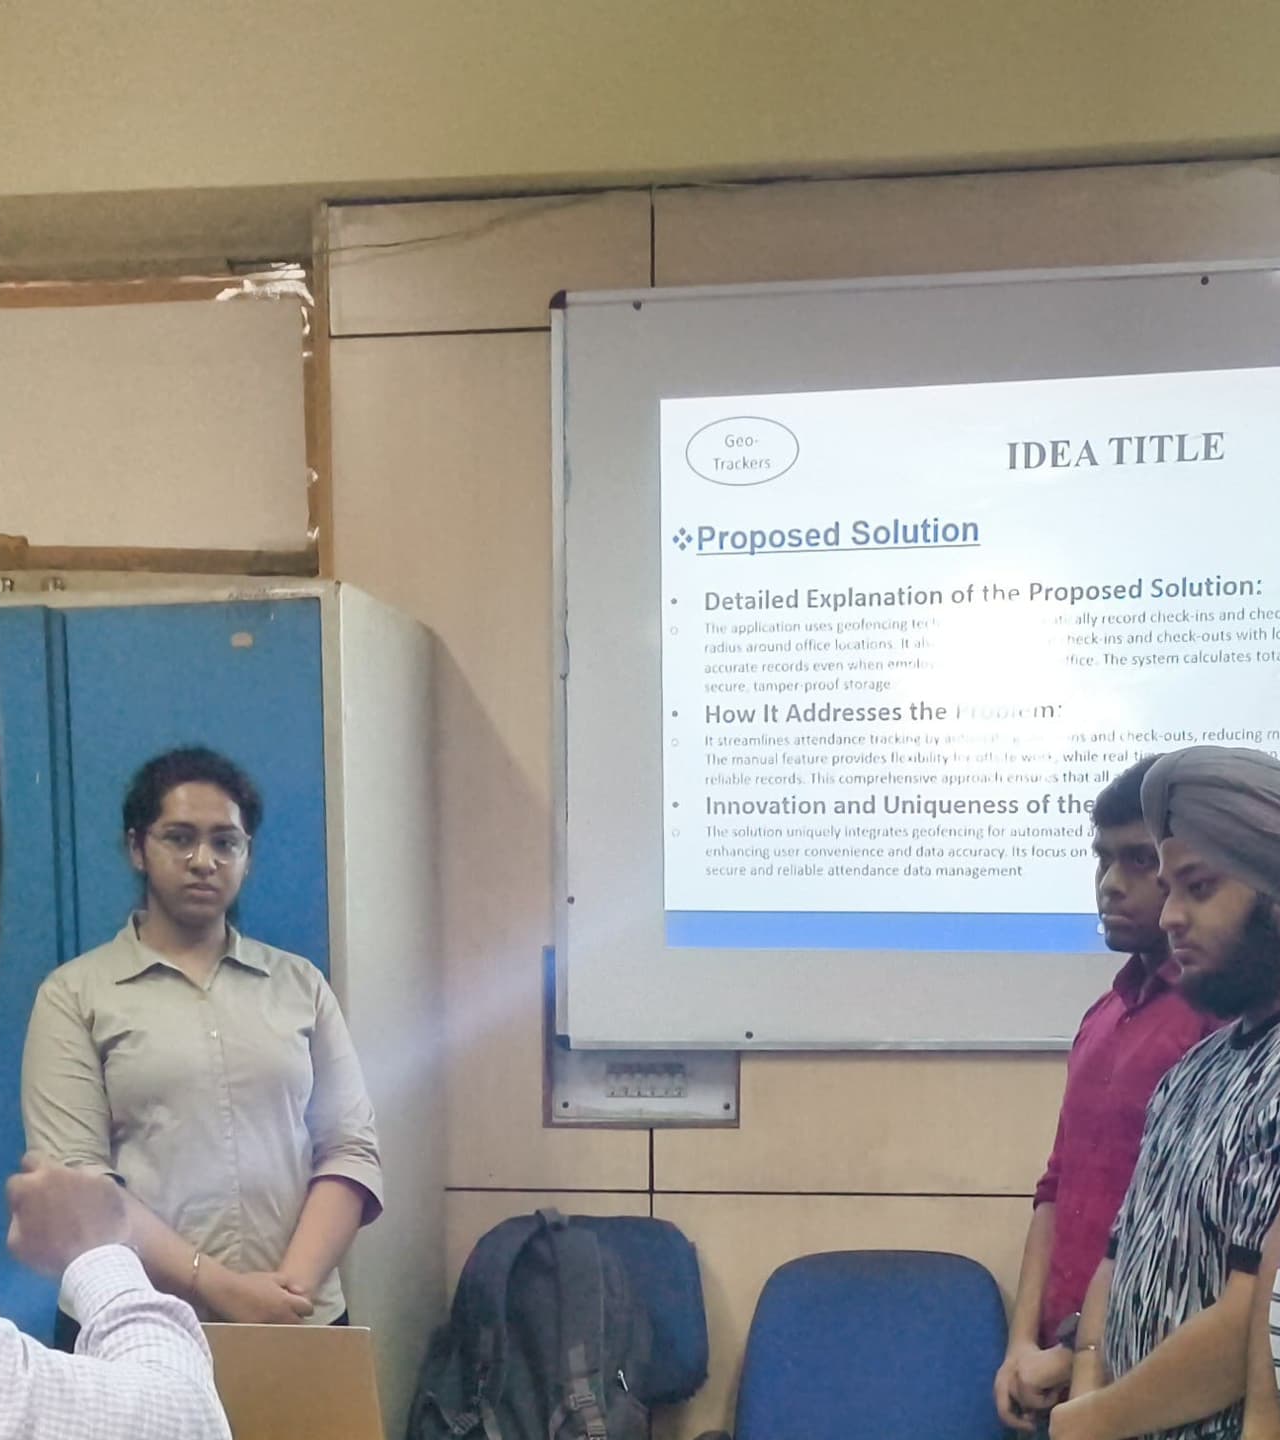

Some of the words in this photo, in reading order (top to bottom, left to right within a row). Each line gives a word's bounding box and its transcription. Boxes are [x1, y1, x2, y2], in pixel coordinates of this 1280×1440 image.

[724, 434, 759, 449] Geo-
[1007, 439, 1100, 470] IDEA
[1107, 431, 1226, 465] TITLE
[713, 455, 771, 472] Trackers
[697, 521, 840, 556] Proposed
[851, 517, 981, 547] Solution
[705, 589, 799, 611] Detailed
[807, 586, 942, 612] Explanation
[951, 584, 974, 604] of
[982, 583, 1020, 602] the
[1029, 577, 1142, 606] Proposed
[1150, 575, 1262, 598] Solution:
[705, 622, 728, 635] The
[731, 620, 801, 636] application
[805, 622, 833, 633] uses
[837, 618, 907, 635] geofencing
[1102, 611, 1146, 625] record
[1150, 608, 1215, 624] check-ins
[1219, 608, 1245, 621] and
[704, 641, 741, 654] radius
[746, 640, 791, 653] around
[795, 638, 831, 651] office
[1067, 632, 1123, 646] heck-ins
[1127, 631, 1152, 644] and
[1156, 629, 1232, 643] check-outs
[1236, 628, 1267, 641] with
[704, 661, 757, 675] accurate
[762, 660, 809, 673] records
[813, 662, 843, 672] even
[847, 659, 883, 671] when
[1104, 652, 1128, 666] The
[1132, 655, 1179, 668] system
[1183, 649, 1252, 664] calculates
[705, 704, 756, 724] How
[764, 704, 778, 723] It
[785, 702, 902, 723] Addresses
[909, 701, 947, 721] the
[718, 734, 790, 747] streamlines
[794, 733, 866, 747] attendance
[1091, 730, 1115, 743] and
[1202, 728, 1261, 743] reducing
[706, 753, 727, 766] The
[732, 752, 778, 766] manual
[782, 751, 827, 765] feature
[832, 751, 887, 767] provides
[1063, 750, 1098, 763] while
[705, 773, 751, 786] reliable
[811, 773, 835, 785] This
[839, 771, 937, 788] comprehensive
[1063, 770, 1089, 784] that
[1094, 769, 1109, 783] all
[705, 795, 826, 816] Innovation
[833, 795, 876, 816] and
[884, 795, 1019, 820] Uniqueness
[1026, 793, 1051, 815] of
[1057, 793, 1096, 815] the
[706, 826, 728, 838] The
[732, 825, 782, 839] solution
[786, 825, 840, 841] uniquely
[845, 825, 909, 841] integrates
[912, 824, 983, 840] geofencing
[987, 824, 1006, 838] for
[1010, 824, 1083, 838] automated
[705, 845, 770, 860] enhancing
[774, 848, 800, 858] user
[804, 846, 884, 859] convenience
[888, 845, 913, 858] and
[916, 845, 944, 858] data
[1032, 844, 1067, 858] focus
[1070, 848, 1088, 858] on
[705, 866, 746, 877] secure
[750, 864, 773, 877] and
[777, 864, 823, 877] reliable
[827, 863, 899, 877] attendance
[903, 863, 931, 877] data
[935, 864, 1023, 880] management
